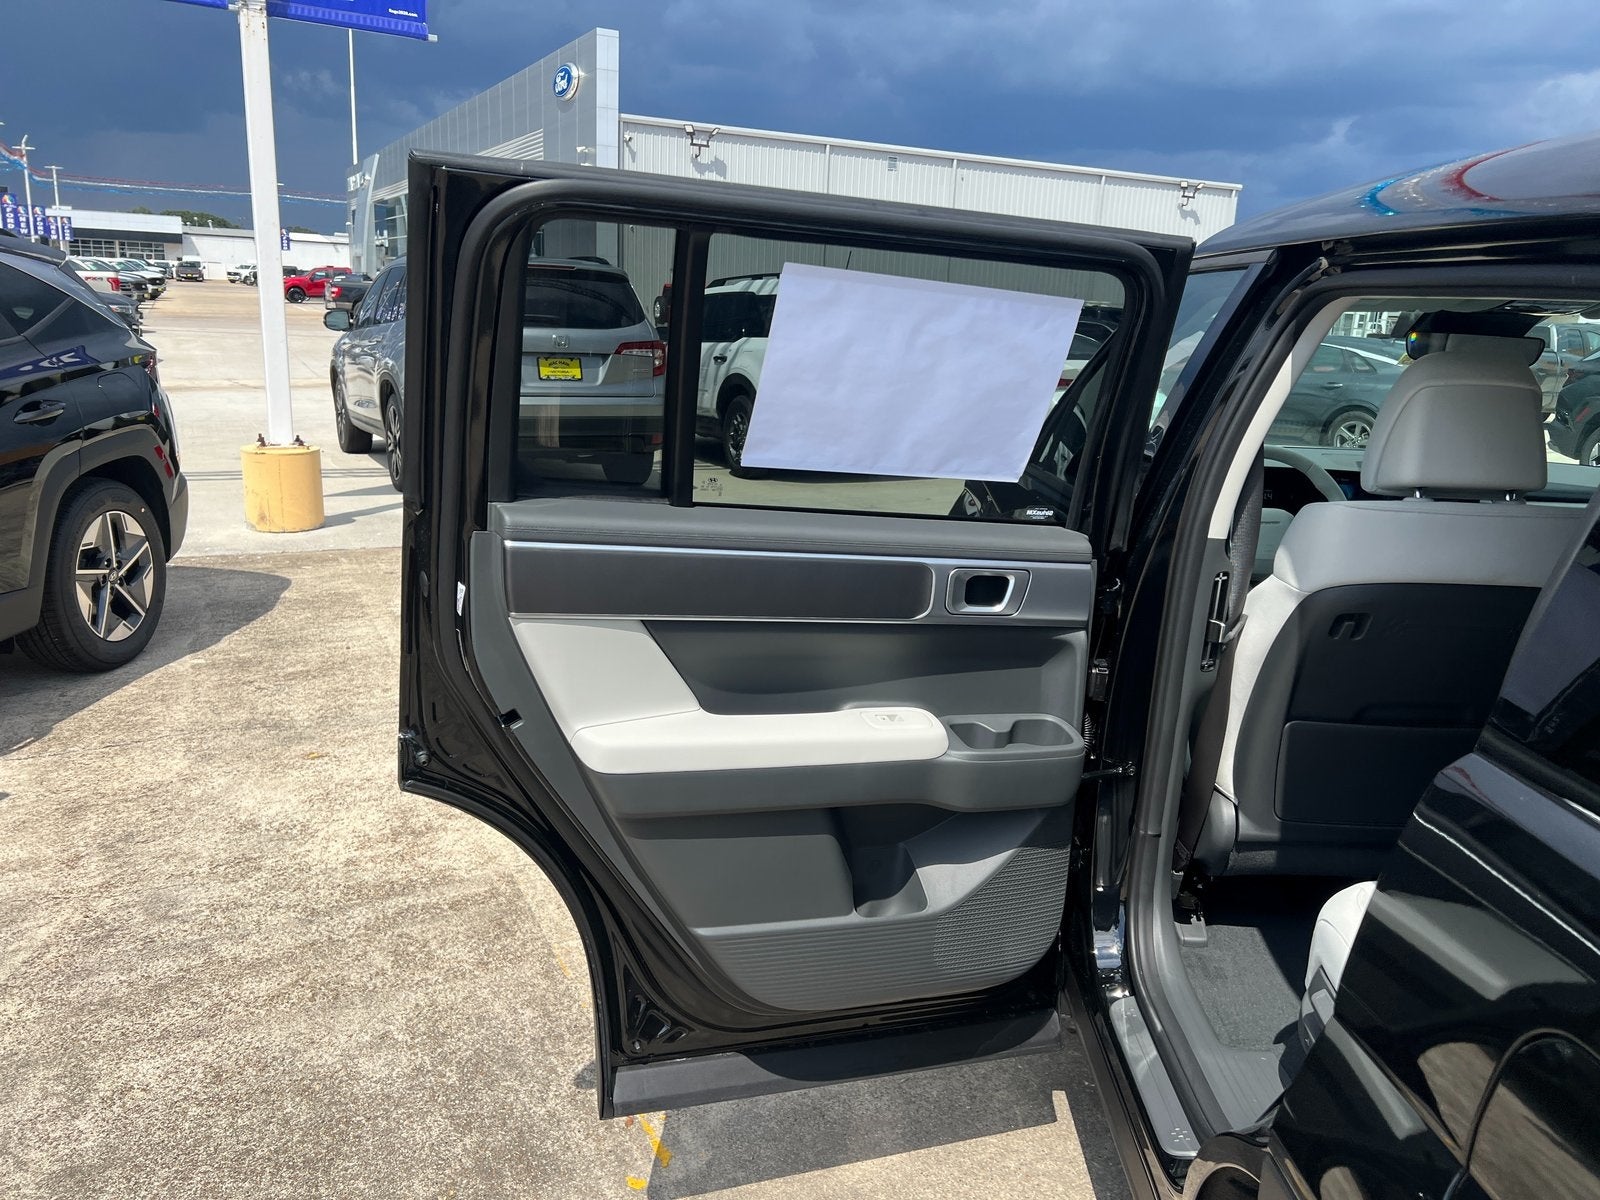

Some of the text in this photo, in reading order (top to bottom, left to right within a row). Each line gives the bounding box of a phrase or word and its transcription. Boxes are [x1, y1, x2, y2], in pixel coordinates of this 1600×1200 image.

[555, 71, 568, 93] Ford
[6, 207, 15, 229] FORD
[19, 216, 28, 234] NEW
[36, 217, 44, 235] FORD
